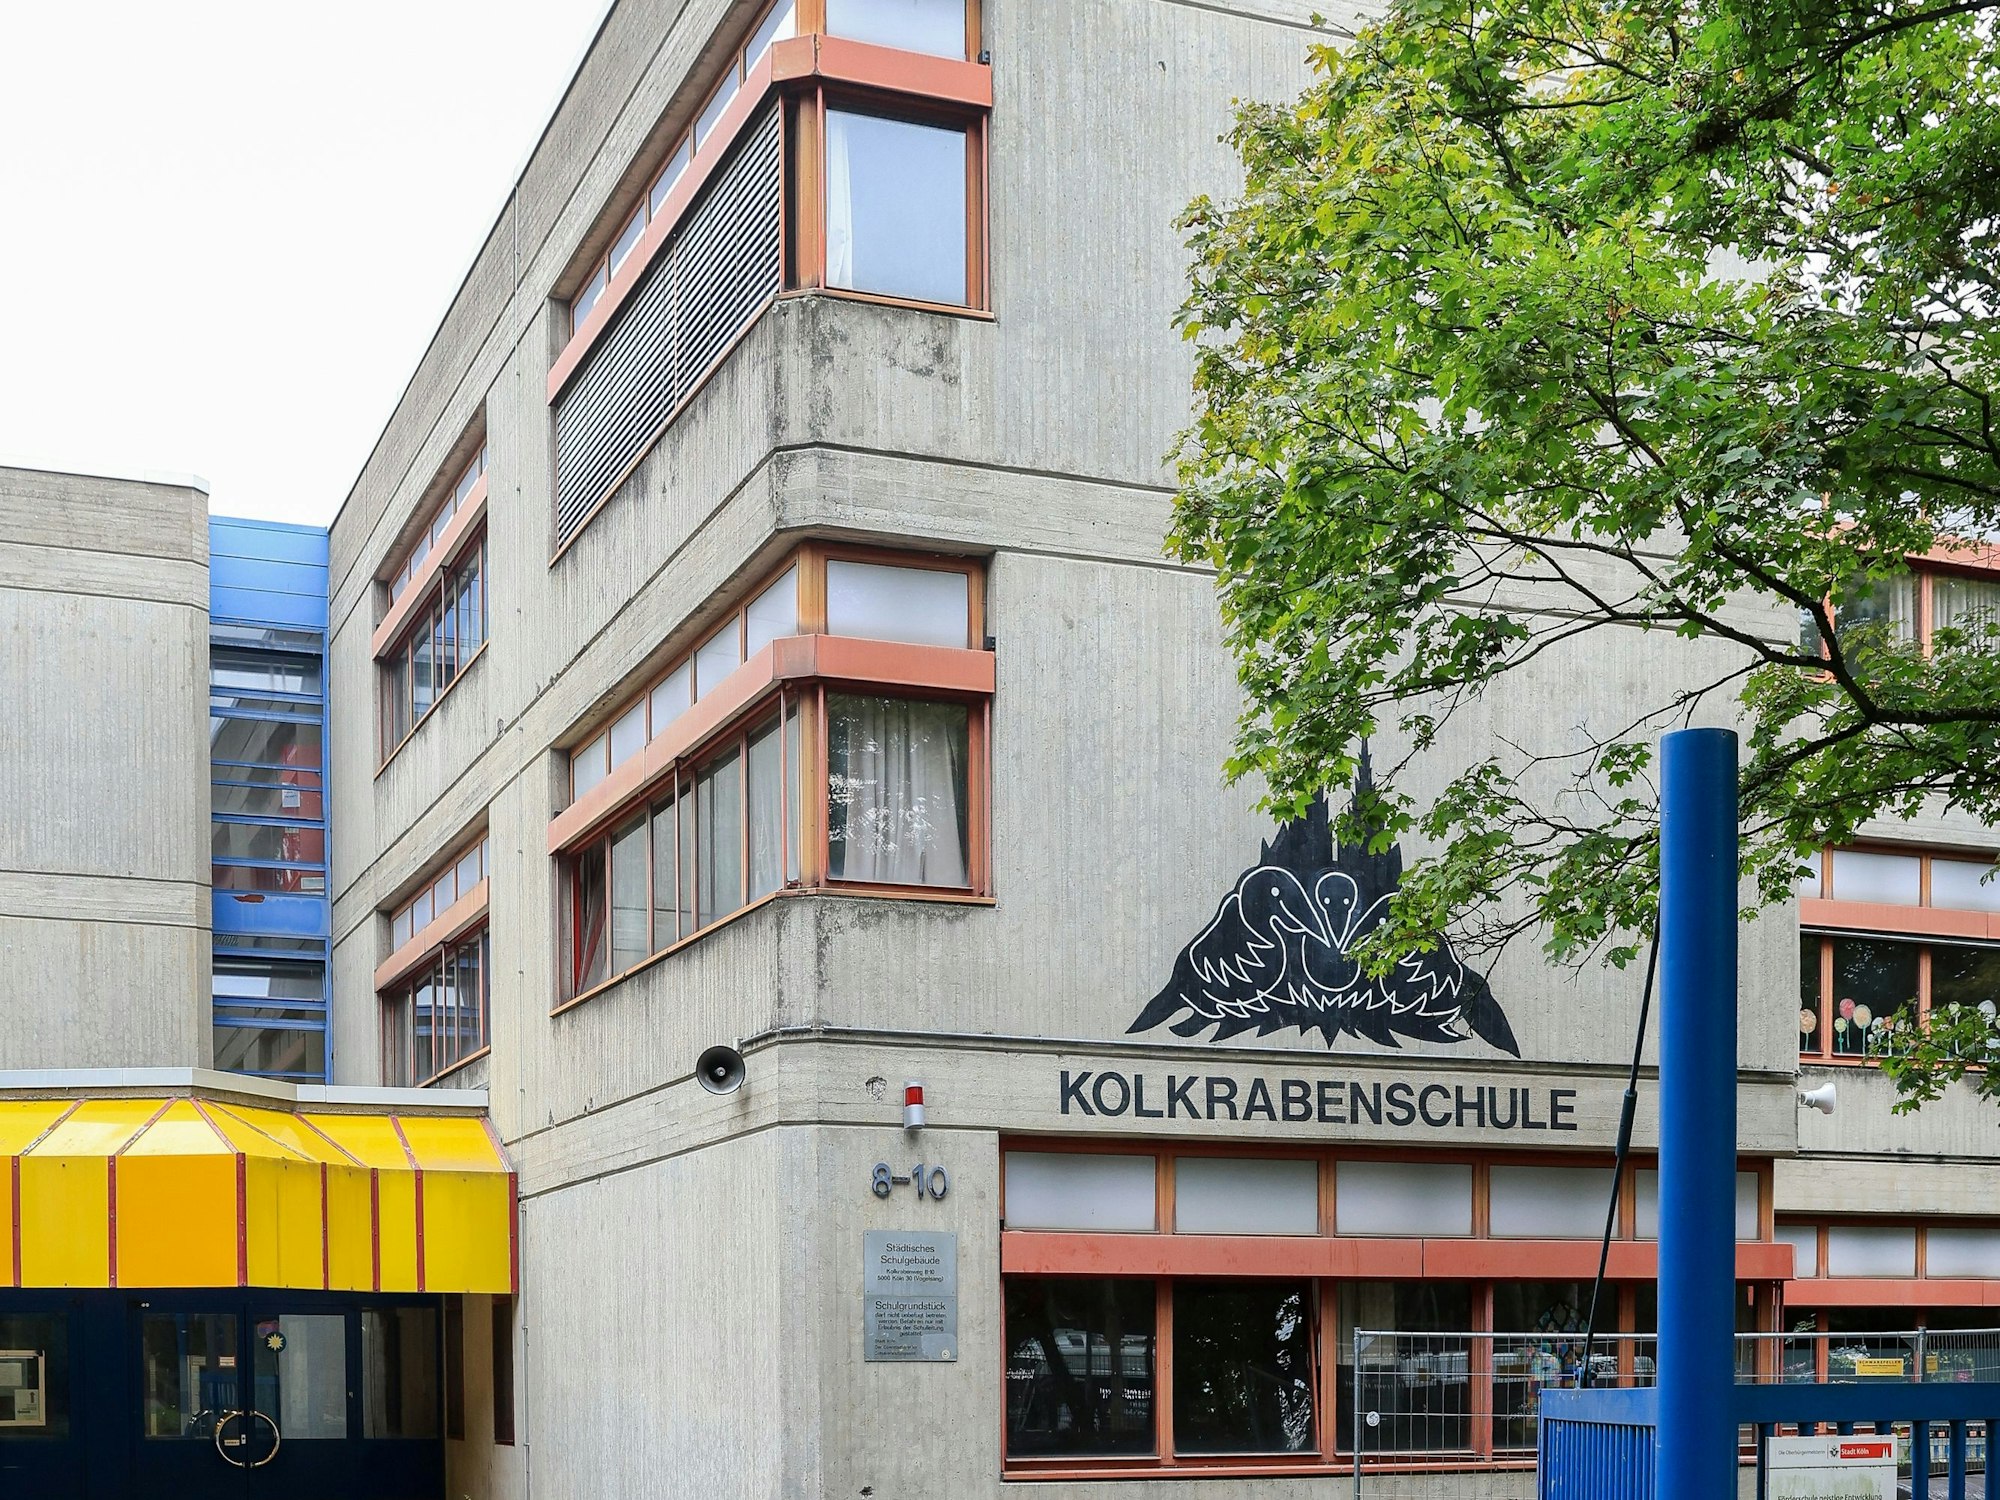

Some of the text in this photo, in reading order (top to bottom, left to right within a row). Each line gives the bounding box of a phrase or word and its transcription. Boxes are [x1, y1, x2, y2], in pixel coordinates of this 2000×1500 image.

[1060, 1070, 1577, 1131] KOLKRABENSCHULE
[872, 1162, 950, 1200] 8-10
[886, 1243, 935, 1253] Städtisches
[880, 1255, 940, 1266] Schulgebäude
[875, 1301, 946, 1311] Schulgrundstück
[1841, 1447, 1870, 1455] Stadt Köln
